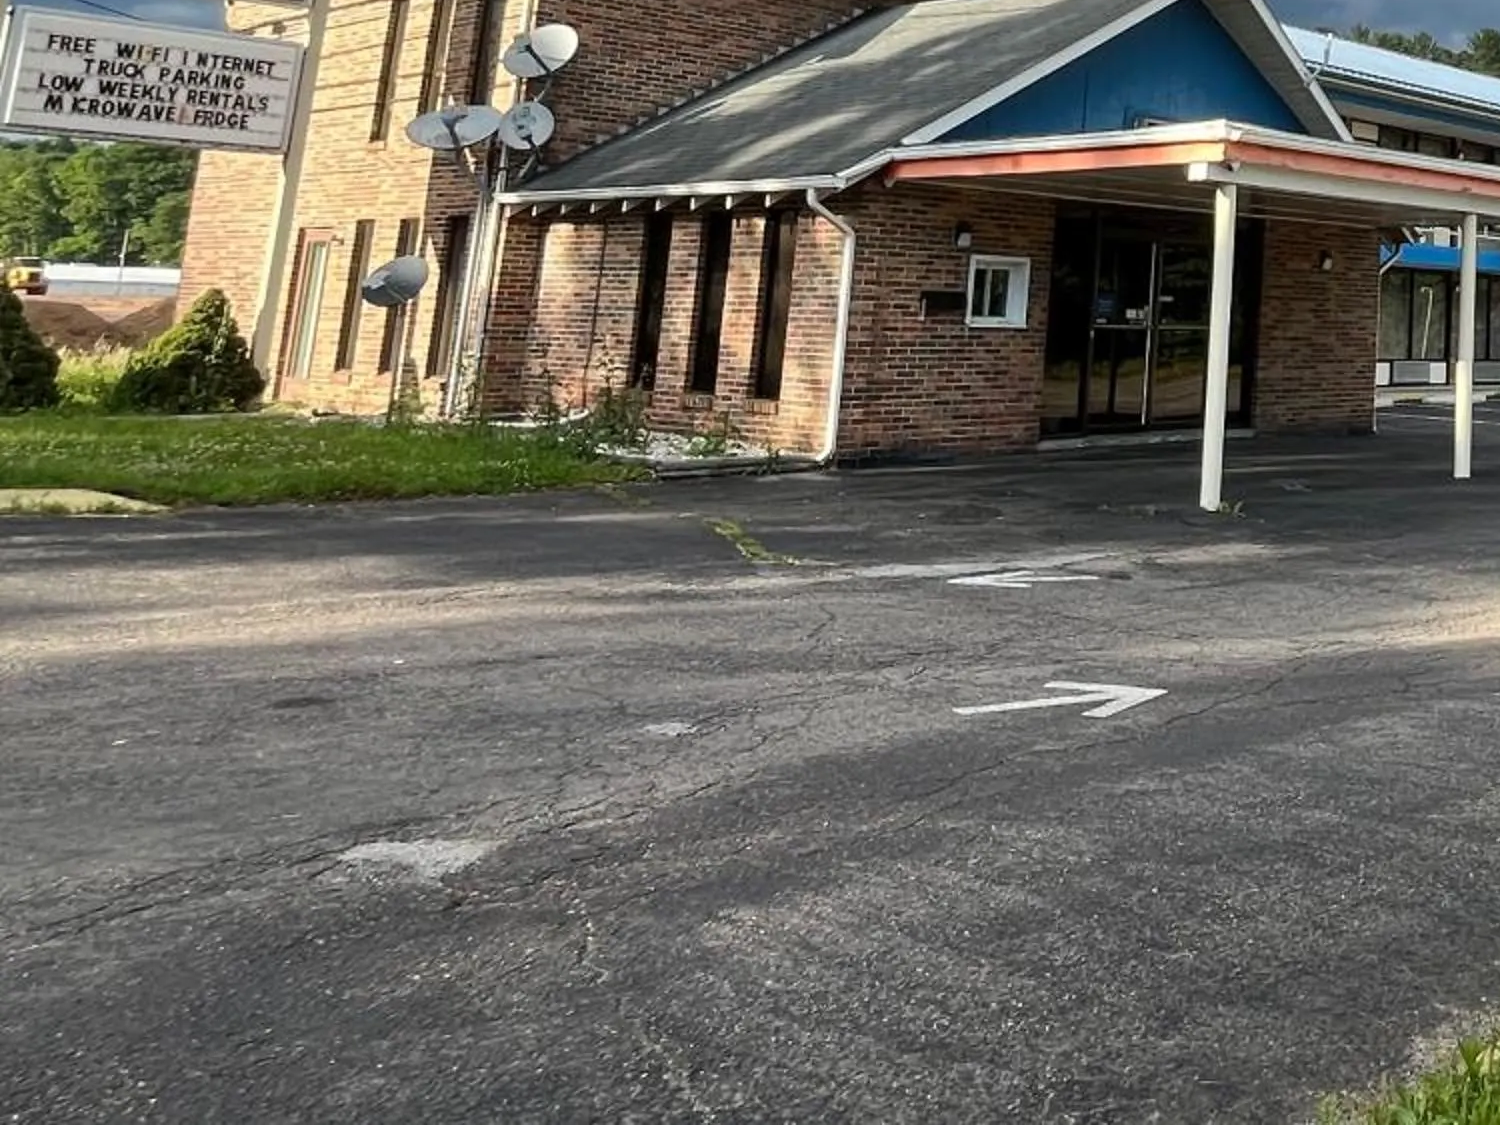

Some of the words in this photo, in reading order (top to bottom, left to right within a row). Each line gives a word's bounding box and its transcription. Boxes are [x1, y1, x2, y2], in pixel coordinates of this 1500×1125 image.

[48, 34, 97, 54] FREE
[84, 58, 147, 79] TRUCK
[159, 66, 245, 90] PARKING
[38, 72, 84, 92] LOW
[99, 79, 180, 103] WEEKLY
[186, 89, 269, 112] RENTALS
